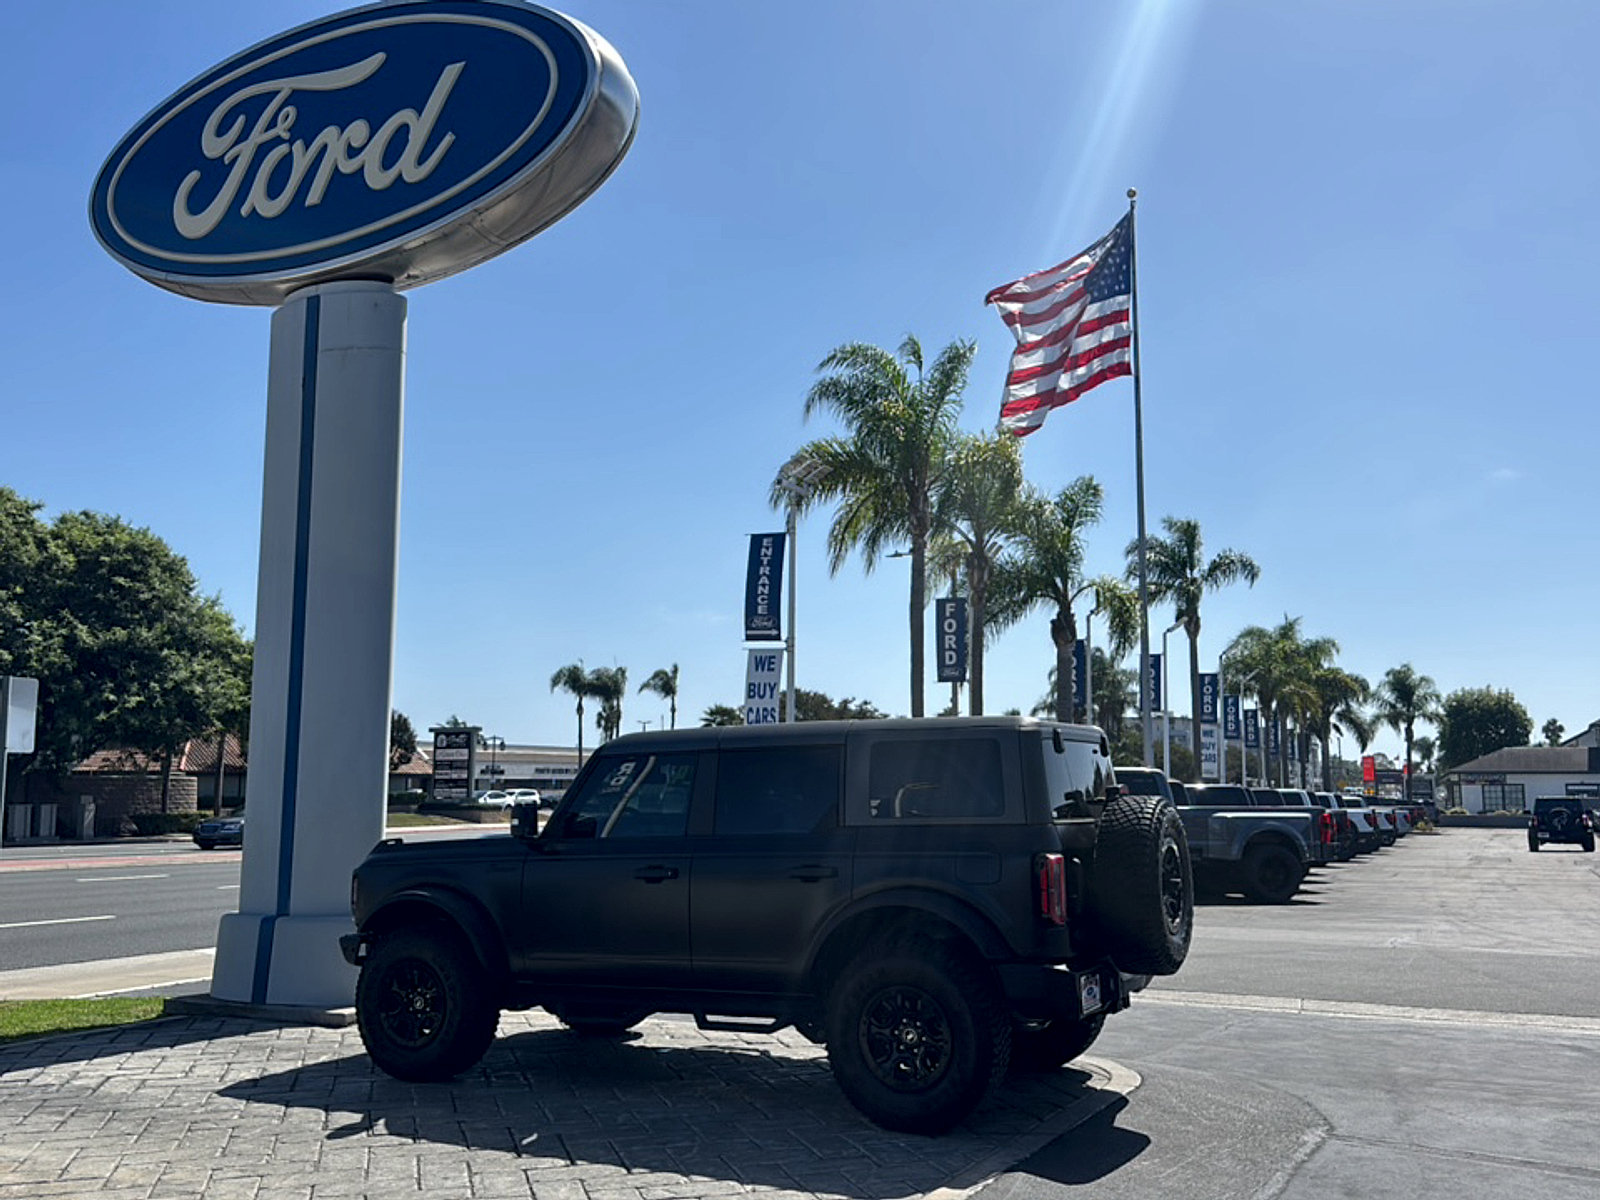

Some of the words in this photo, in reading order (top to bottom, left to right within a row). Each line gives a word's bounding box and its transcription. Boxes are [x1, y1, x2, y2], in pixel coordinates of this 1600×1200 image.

[173, 51, 466, 239] Ford
[757, 537, 773, 614] ENTRANCE
[944, 603, 957, 665] FORD
[754, 655, 777, 672] WE
[748, 682, 777, 699] BUY
[1203, 676, 1213, 713] FORD
[747, 706, 776, 724] CARS
[1227, 697, 1236, 730] FORD
